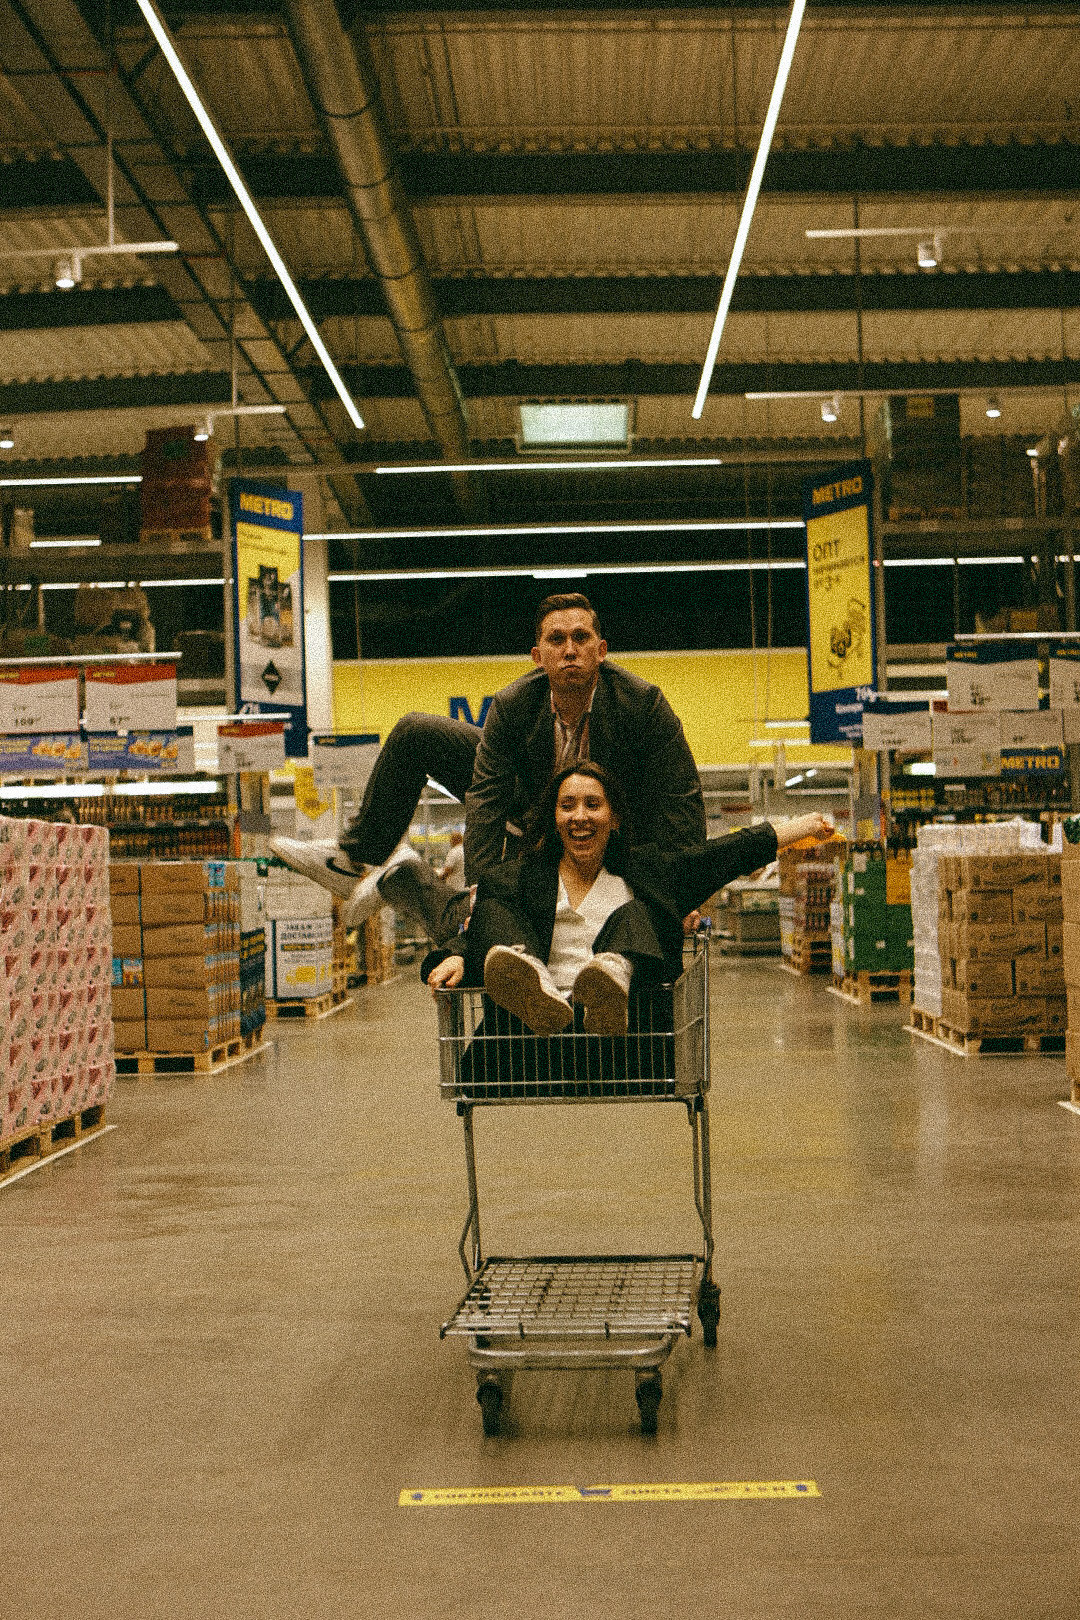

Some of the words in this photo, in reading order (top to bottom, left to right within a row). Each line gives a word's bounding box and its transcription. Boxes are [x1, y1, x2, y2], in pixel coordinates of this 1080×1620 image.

[811, 475, 863, 505] METRO
[239, 492, 294, 521] METRO
[1000, 755, 1060, 769] METRO
